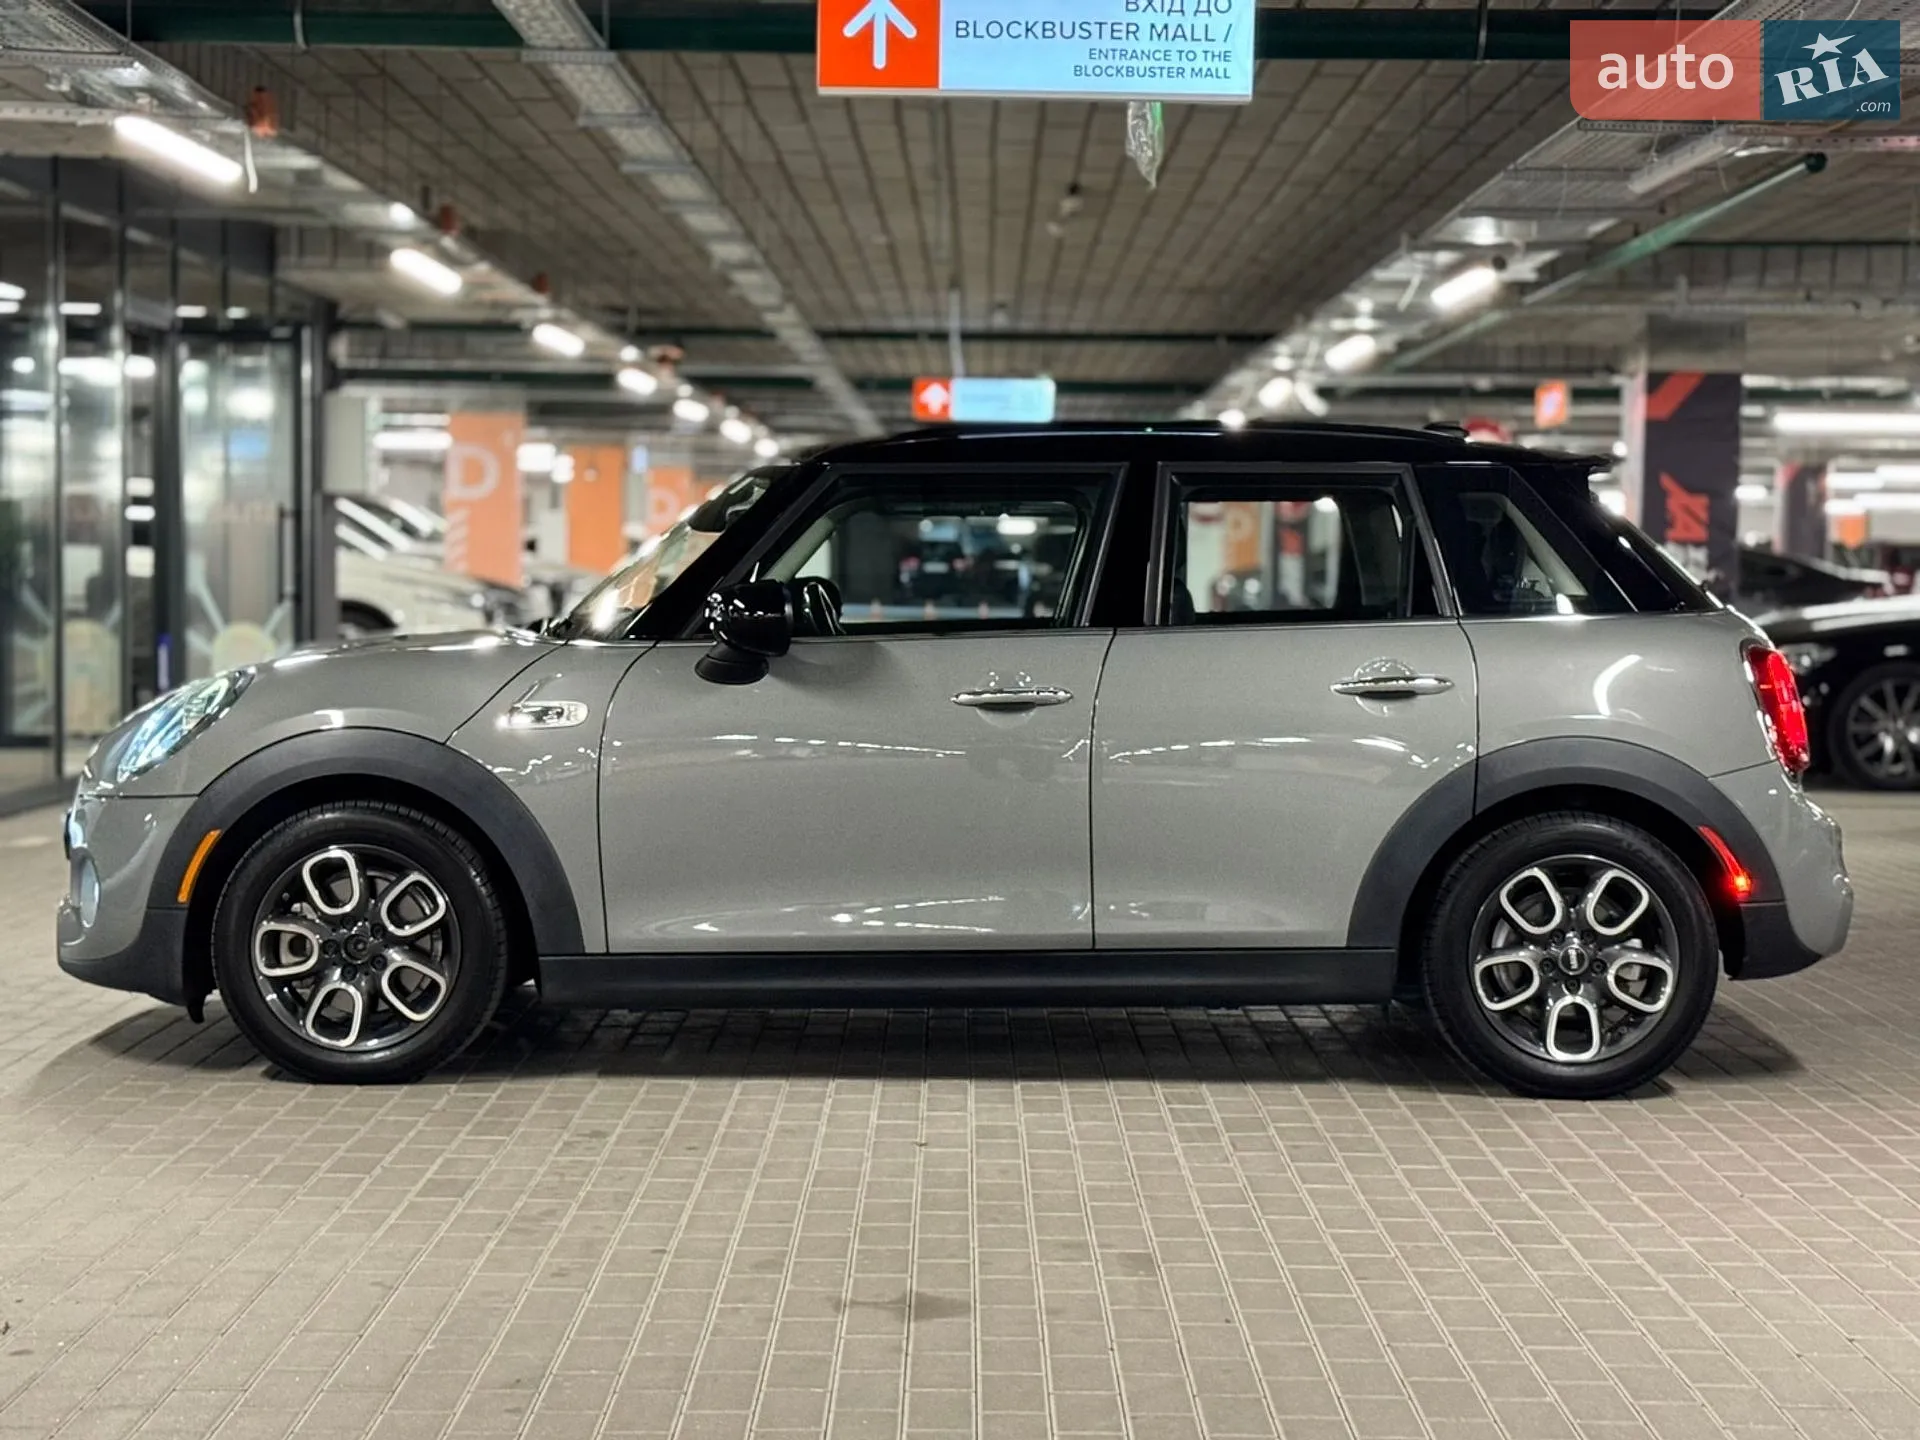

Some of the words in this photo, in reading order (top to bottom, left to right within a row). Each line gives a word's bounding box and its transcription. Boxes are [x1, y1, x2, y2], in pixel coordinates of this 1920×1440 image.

[1125, 0, 1185, 16] ВХІД
[1194, 0, 1232, 16] ДО
[955, 20, 1140, 41] BLOCKBUSTER
[1149, 23, 1216, 42] MALL
[1088, 48, 1171, 62] ENTRANCE
[1176, 49, 1197, 62] TO
[1202, 50, 1232, 63] THE
[1073, 64, 1185, 79] BLOCKBUSTER
[1190, 66, 1231, 80] MALL
[445, 441, 500, 500] D
